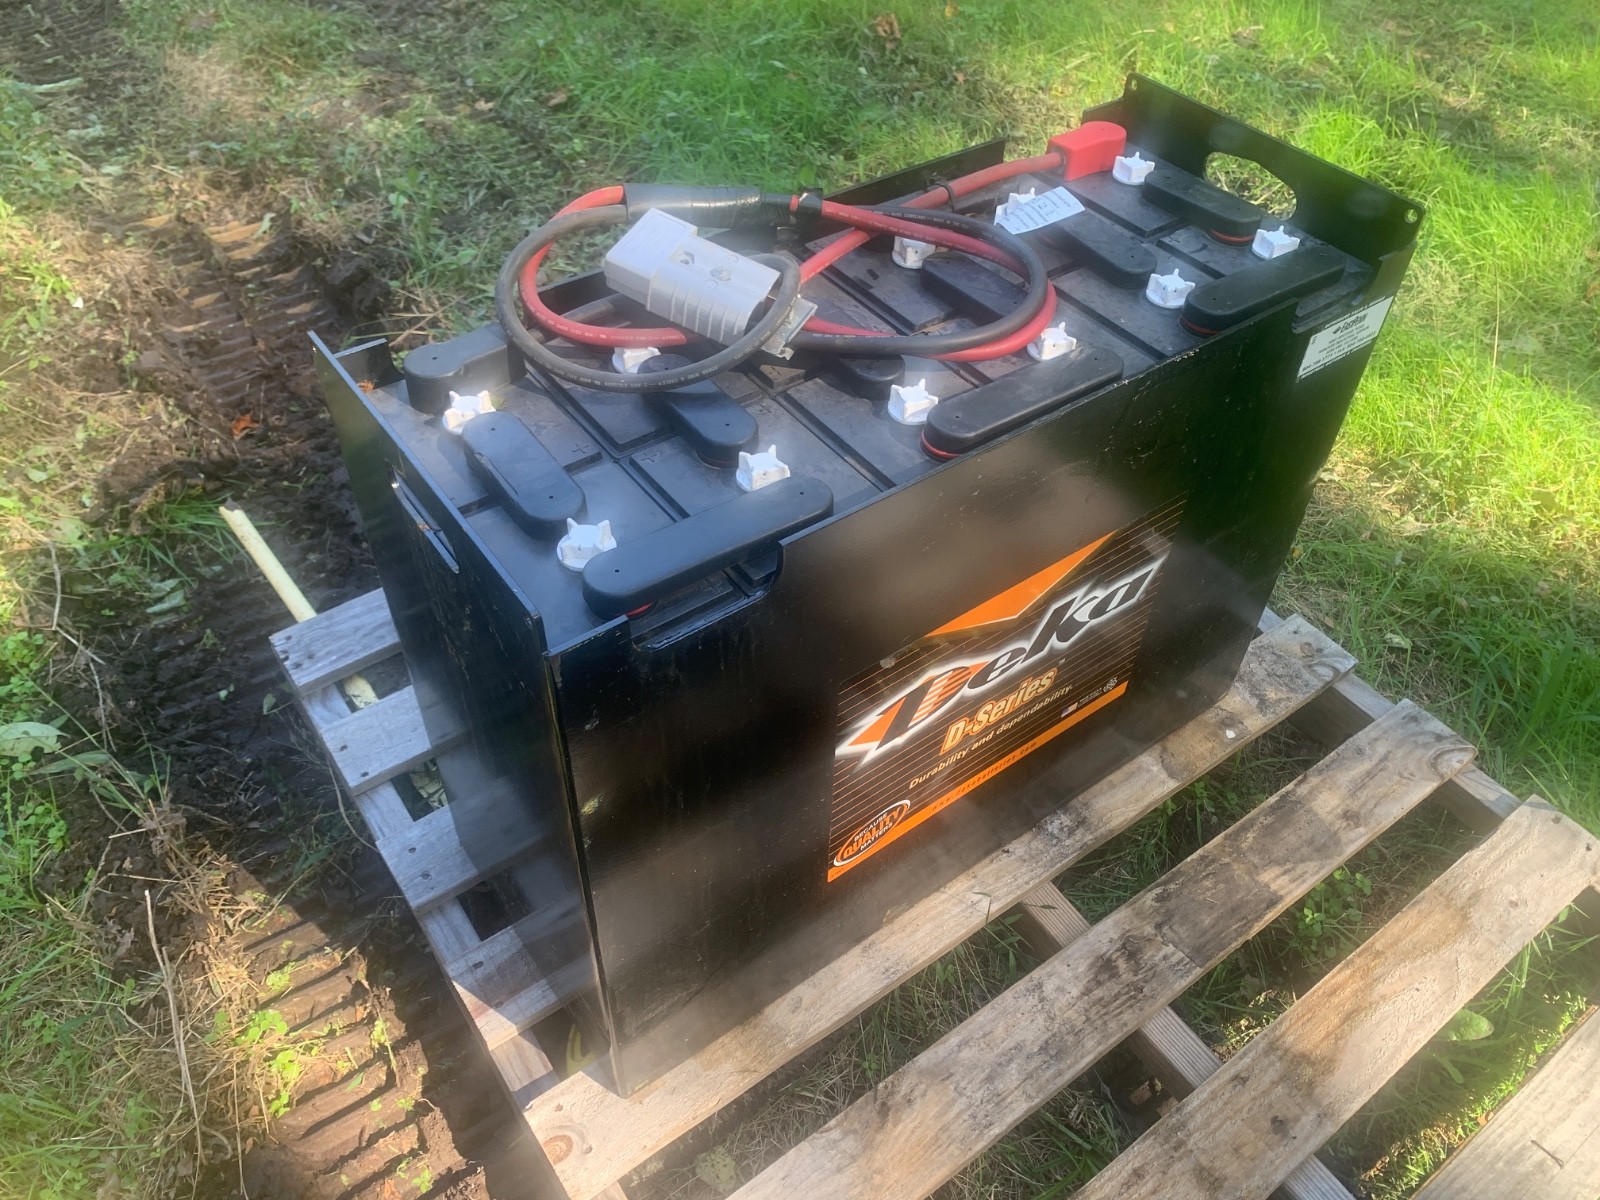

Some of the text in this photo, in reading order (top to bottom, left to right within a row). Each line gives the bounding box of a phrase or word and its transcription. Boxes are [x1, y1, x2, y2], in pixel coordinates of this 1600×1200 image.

[846, 562, 1160, 756] Deka
[908, 747, 970, 790] Durability
[971, 731, 995, 750] and
[996, 685, 1073, 735] dependability.
[940, 668, 1057, 755] D-Series
[843, 806, 901, 859] QUALITY
[854, 812, 888, 842] BECAUSE
[860, 822, 893, 850] MATTERS
